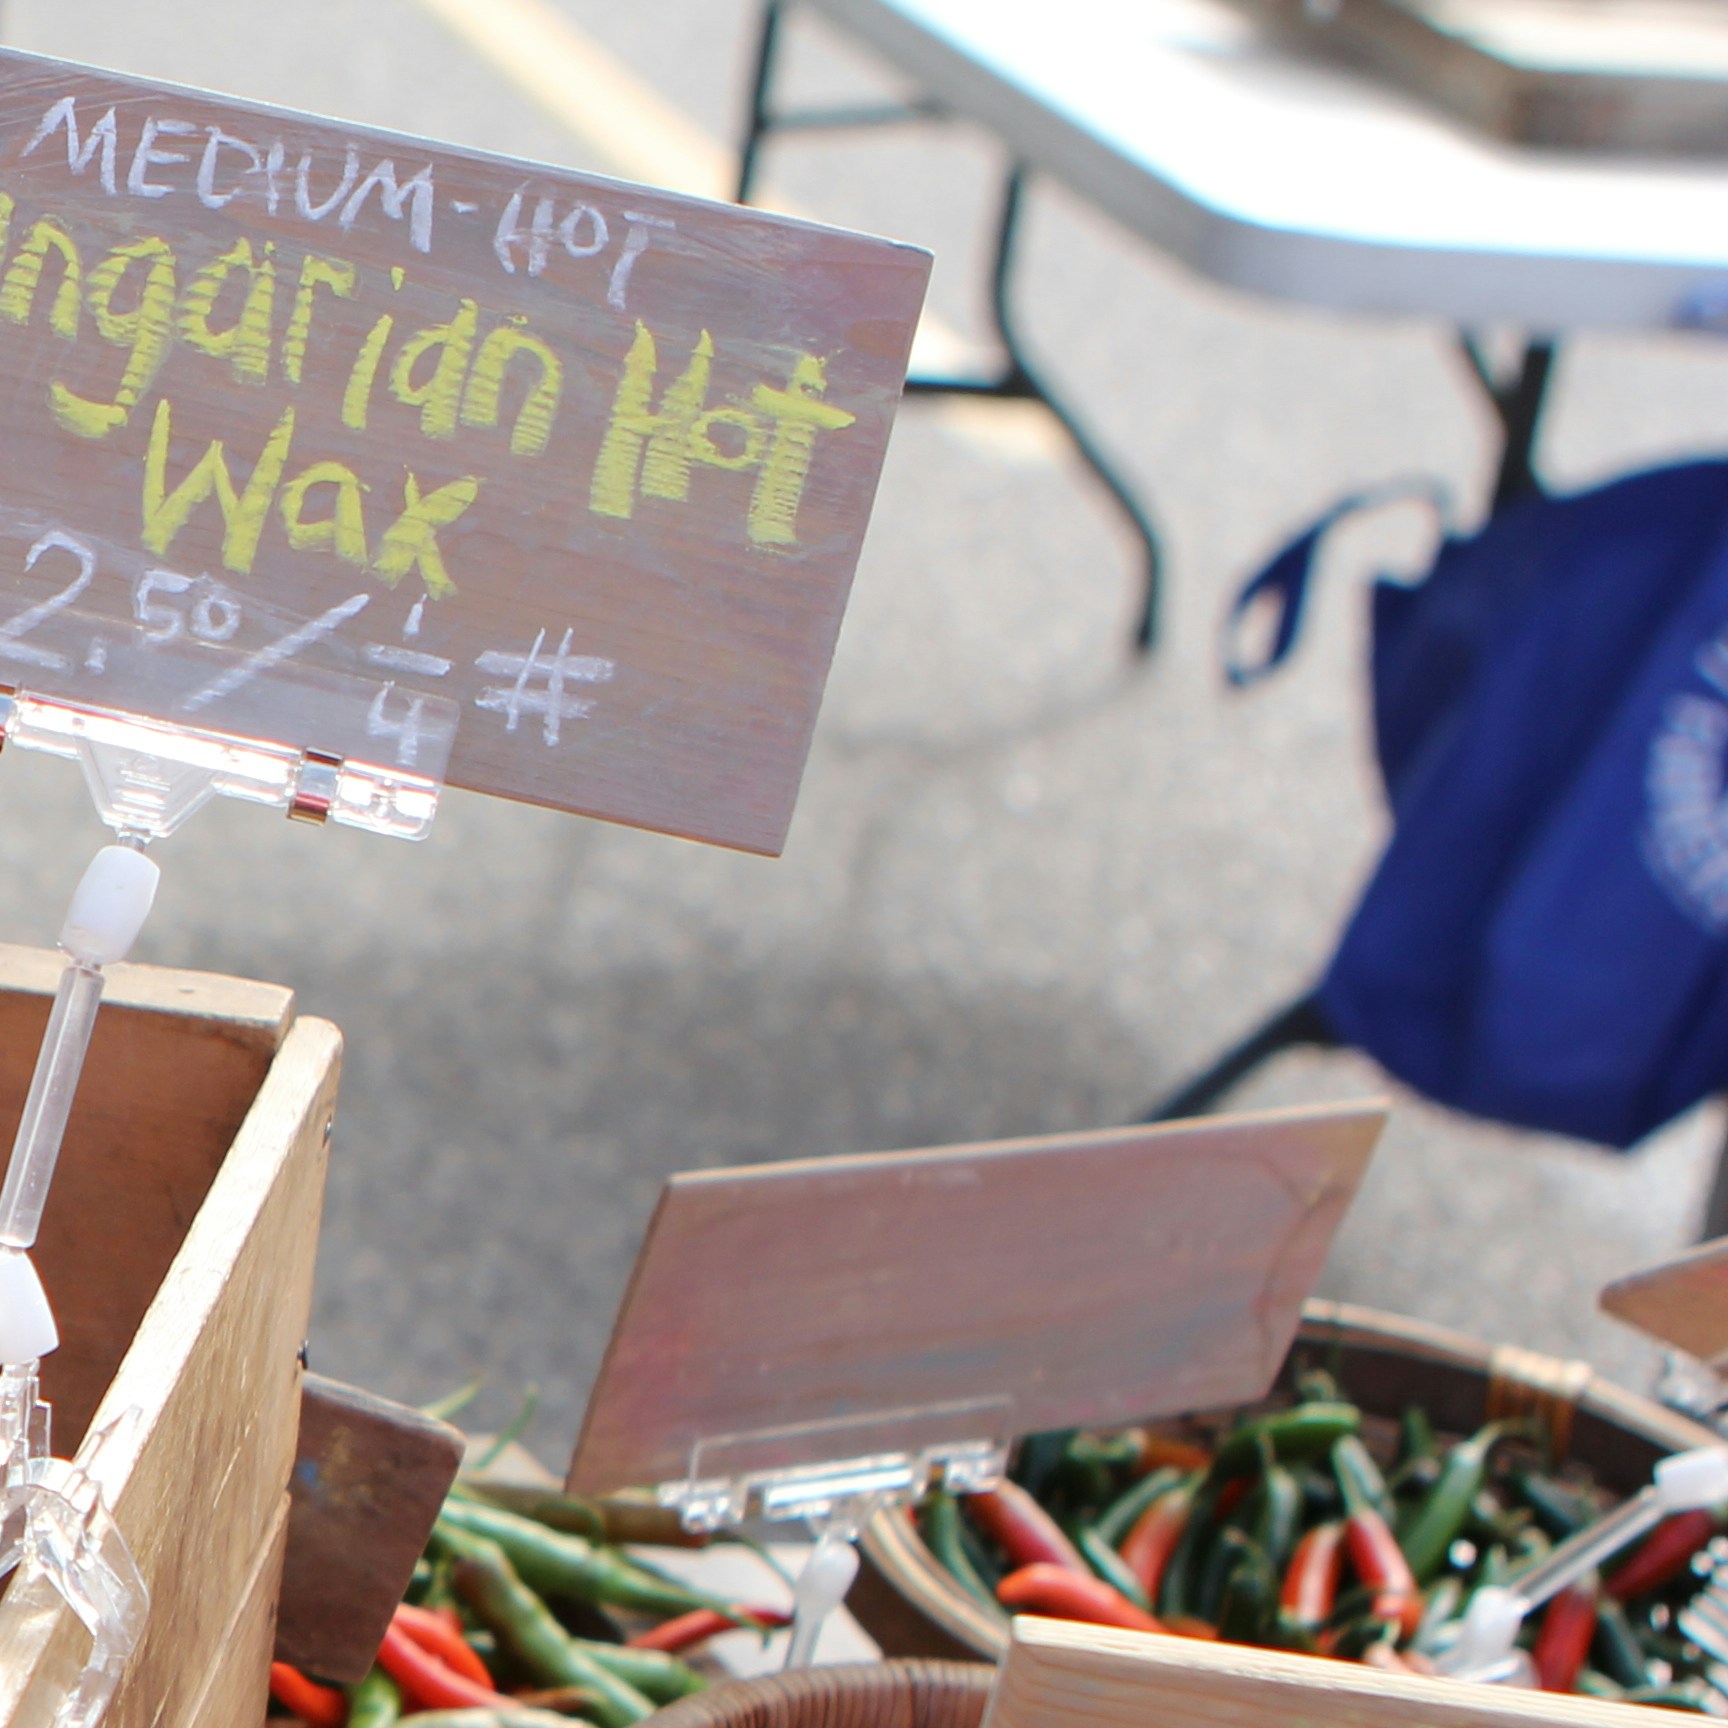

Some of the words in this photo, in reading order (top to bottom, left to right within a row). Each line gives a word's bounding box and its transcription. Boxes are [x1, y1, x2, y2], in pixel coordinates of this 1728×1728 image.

[20, 96, 675, 310] MEDIUM-HOT
[141, 399, 480, 599] Wax
[589, 318, 856, 546] Hot
